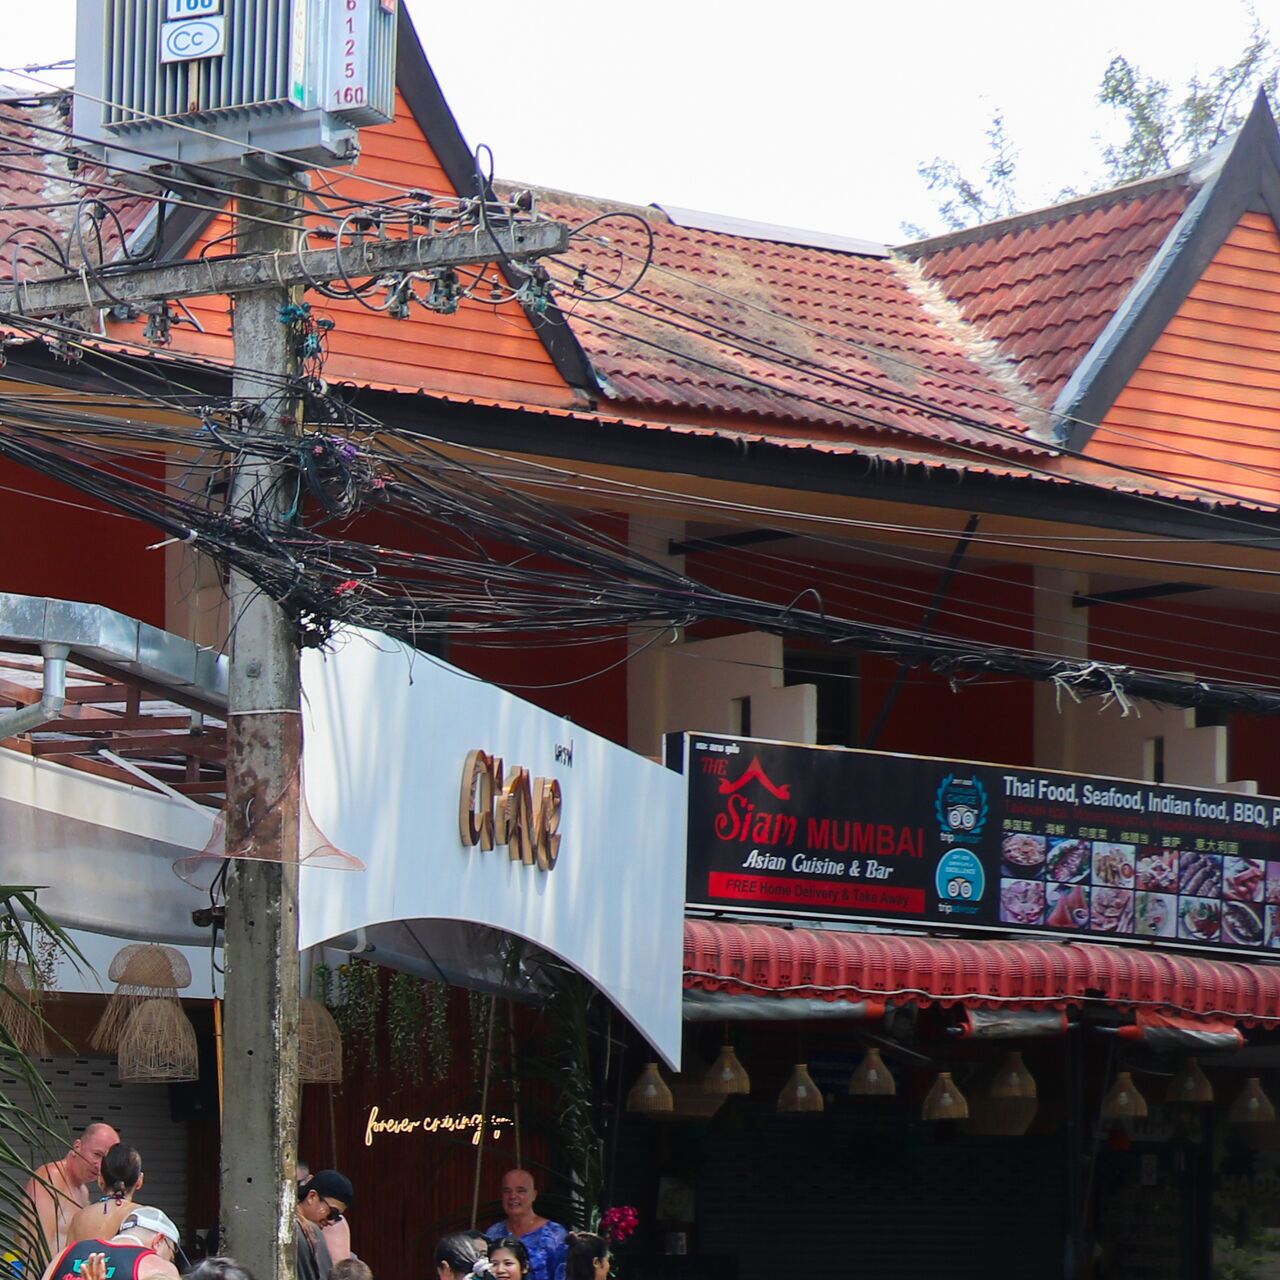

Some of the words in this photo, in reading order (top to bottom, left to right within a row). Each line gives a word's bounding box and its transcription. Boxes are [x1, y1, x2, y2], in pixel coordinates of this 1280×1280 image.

[333, 87, 364, 104] 160
[702, 756, 729, 776] THE
[1003, 776, 1035, 798] Thai
[1038, 780, 1079, 806] Food,
[1083, 784, 1145, 813] Seafood,
[1148, 792, 1192, 816] Indian
[1194, 798, 1230, 824] food,
[1233, 802, 1269, 828] BBQ,
[715, 794, 798, 846] Siam
[807, 817, 924, 858] MUMBAI
[742, 849, 787, 871] Asian
[792, 853, 845, 876] Cuisine
[848, 860, 861, 877] &
[866, 860, 894, 880] Bar
[725, 878, 757, 893] FREE
[760, 882, 791, 897] Home
[795, 884, 839, 902] Delivery
